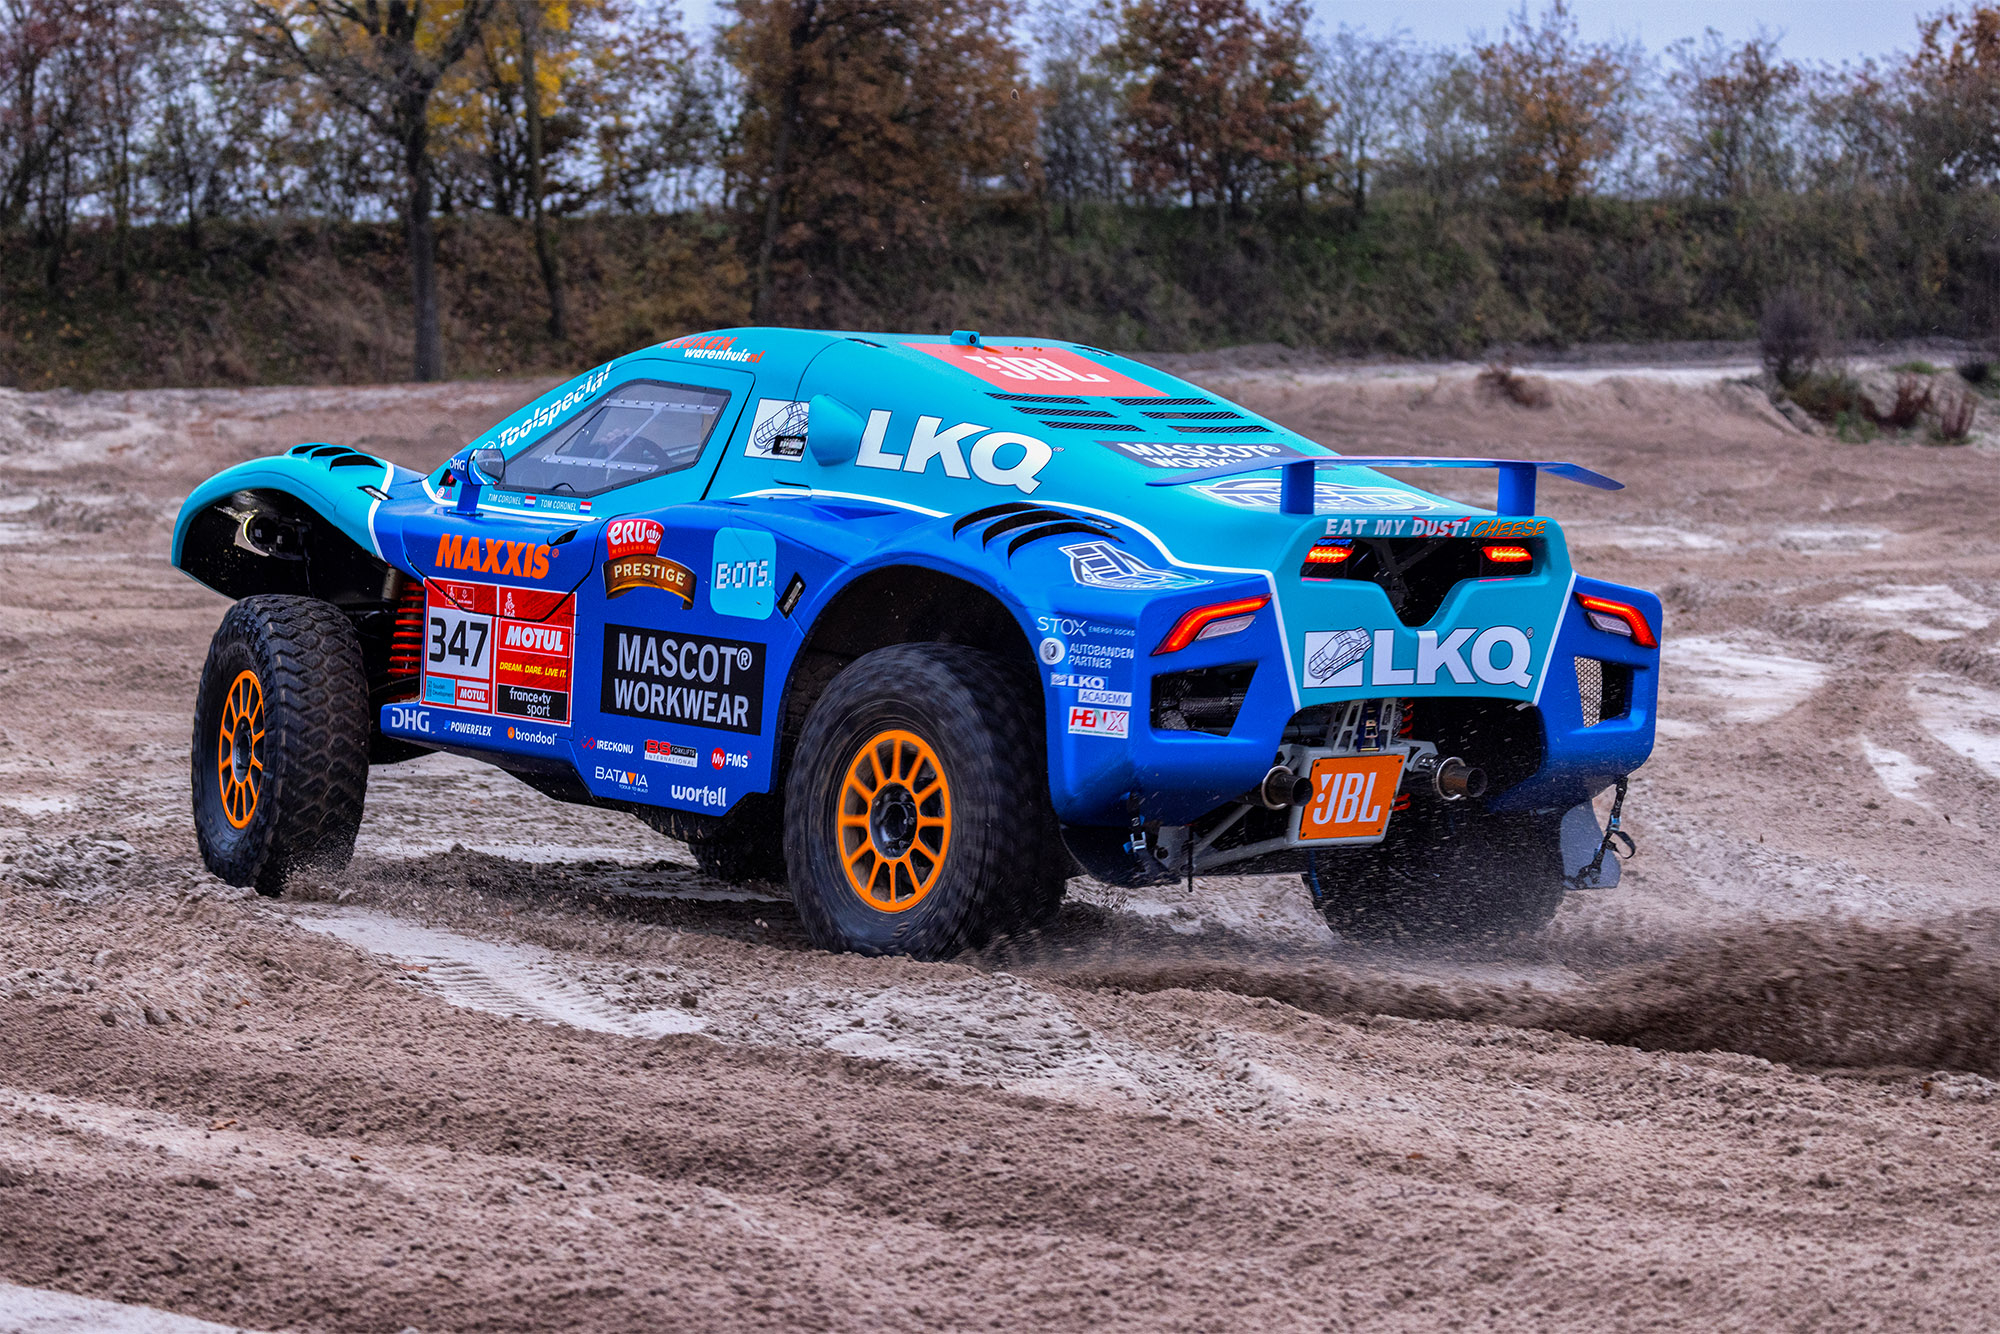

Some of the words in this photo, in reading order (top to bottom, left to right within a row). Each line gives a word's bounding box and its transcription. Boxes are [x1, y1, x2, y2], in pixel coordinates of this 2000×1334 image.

[660, 336, 738, 351] KEUKEN
[963, 355, 1110, 383] JBL
[498, 362, 614, 448] Toolspecial
[497, 494, 521, 505] CORONEL
[541, 499, 553, 508] TOM
[552, 500, 577, 511] CORONEL
[1325, 518, 1368, 535] EAT
[1374, 519, 1406, 536] MY
[1411, 519, 1469, 537] DUST!
[1471, 518, 1547, 537] CHEESE
[614, 563, 686, 587] PRESTIGE
[1036, 616, 1088, 637] STOX
[428, 617, 489, 668] 347
[505, 625, 564, 652] MOTUL
[1069, 642, 1135, 660] AUTOBANDEN
[499, 662, 523, 673] DREAM.
[524, 665, 543, 675] DARE.
[544, 667, 559, 677] LIVE
[1067, 655, 1112, 669] PARTNER
[1067, 675, 1105, 690] LKQ
[459, 688, 486, 701] MOTUL
[614, 678, 749, 728] WORKWEAR
[1081, 691, 1128, 704] ACADEMY
[526, 704, 551, 718] sport
[391, 708, 430, 733] DHG
[450, 721, 492, 737] POWERFLEX
[596, 739, 634, 755] IRECKONU
[646, 739, 671, 756] BS
[645, 753, 696, 766] INTERNATIONAL
[594, 766, 648, 788] BATAVIA
[671, 784, 727, 807] wortell
[1312, 773, 1381, 825] JBL
